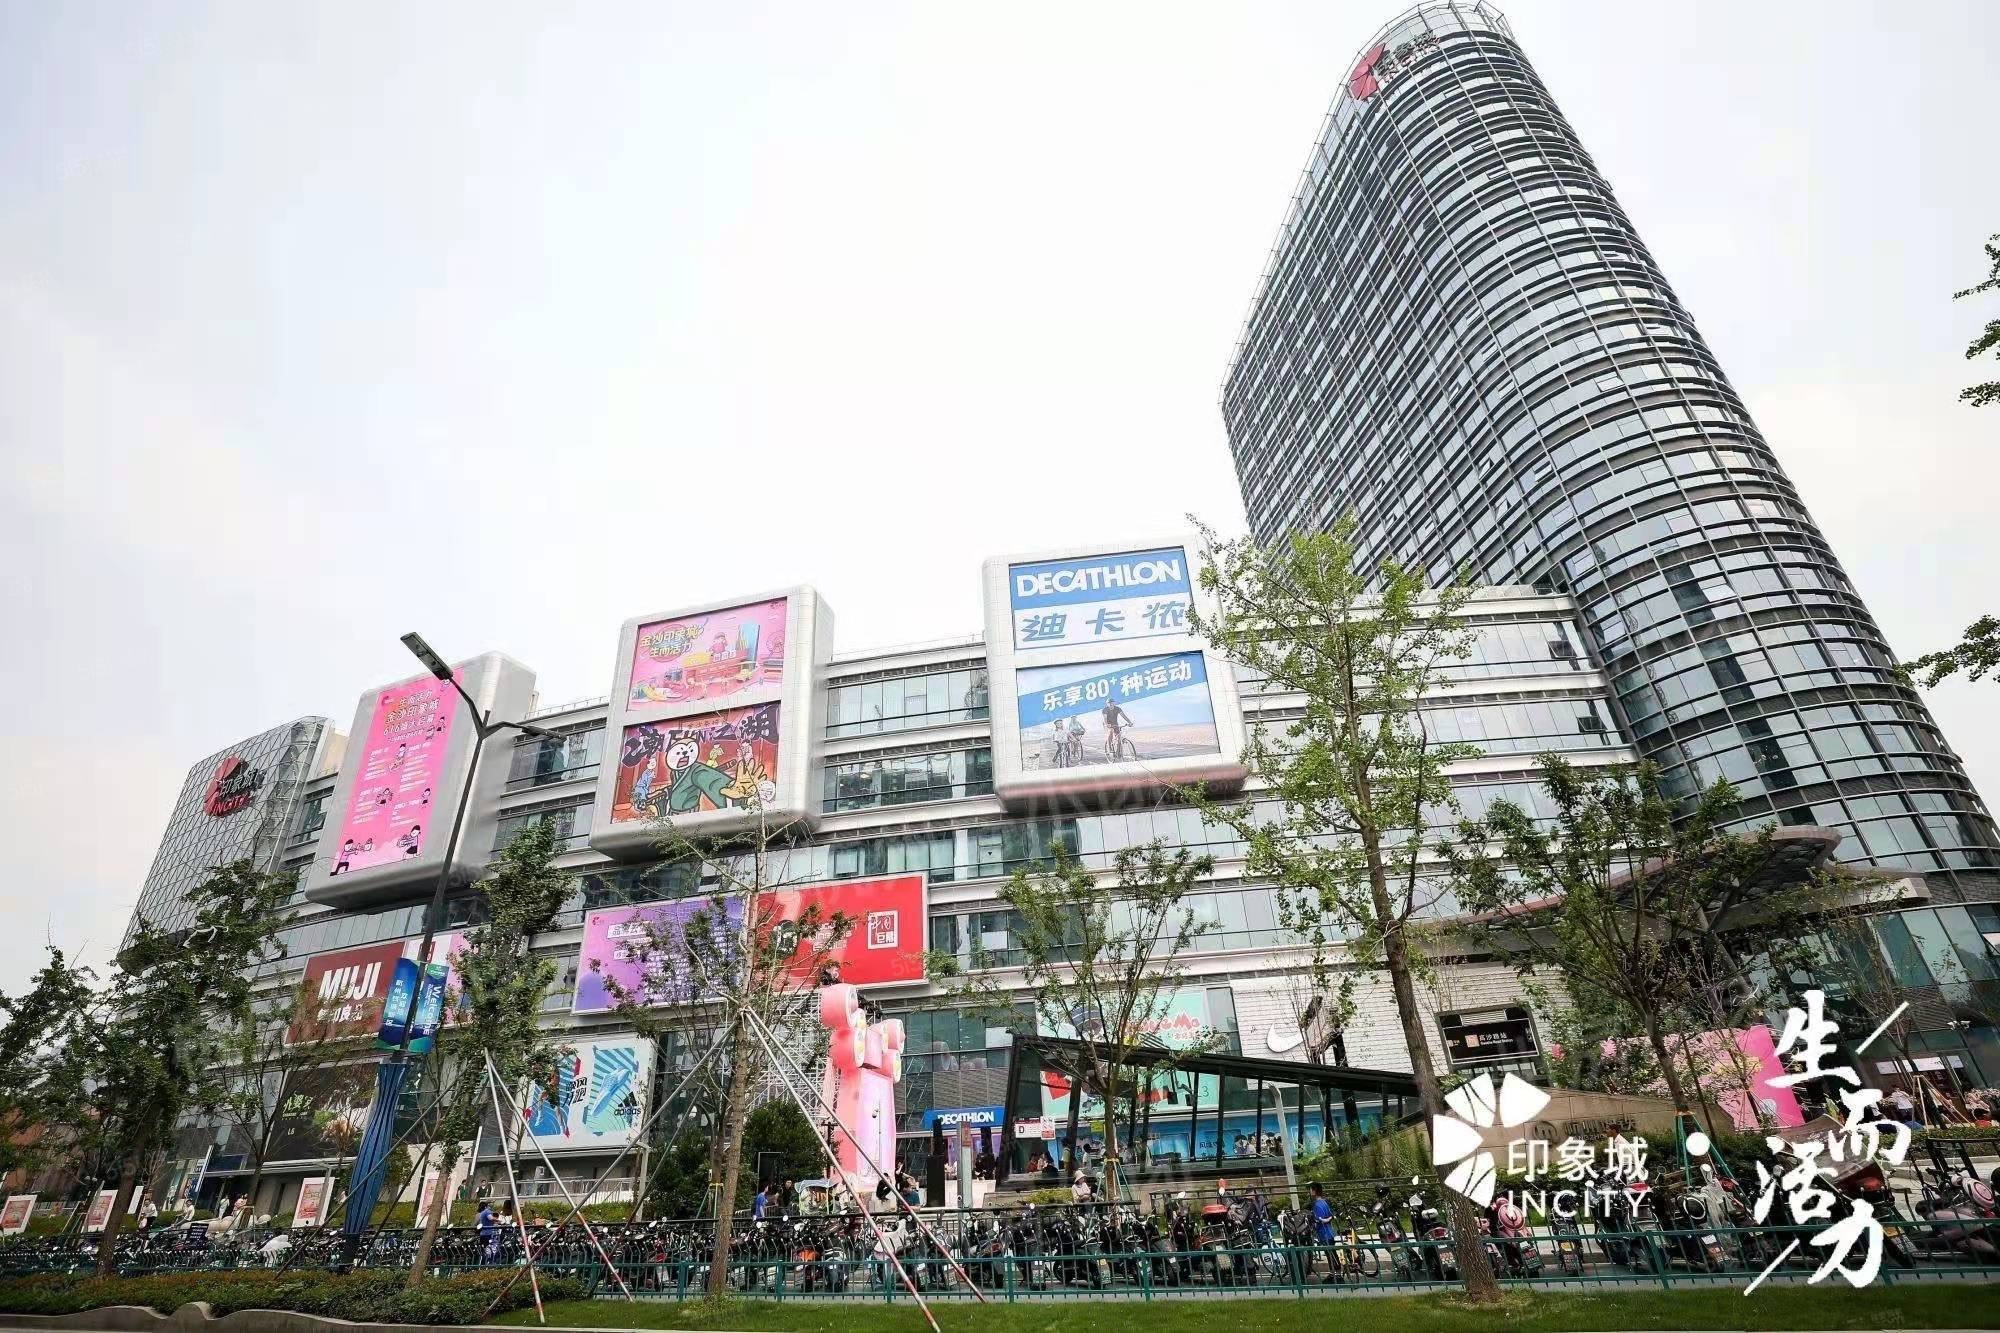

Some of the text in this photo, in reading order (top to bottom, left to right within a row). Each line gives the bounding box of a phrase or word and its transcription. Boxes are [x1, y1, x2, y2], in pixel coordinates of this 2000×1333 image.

[1016, 558, 1182, 598] DECATHLON
[1022, 600, 1188, 642] 迪卡侬
[317, 961, 383, 1001] MUJI
[614, 1107, 642, 1117] adidas
[937, 1111, 995, 1126] DECATHLON
